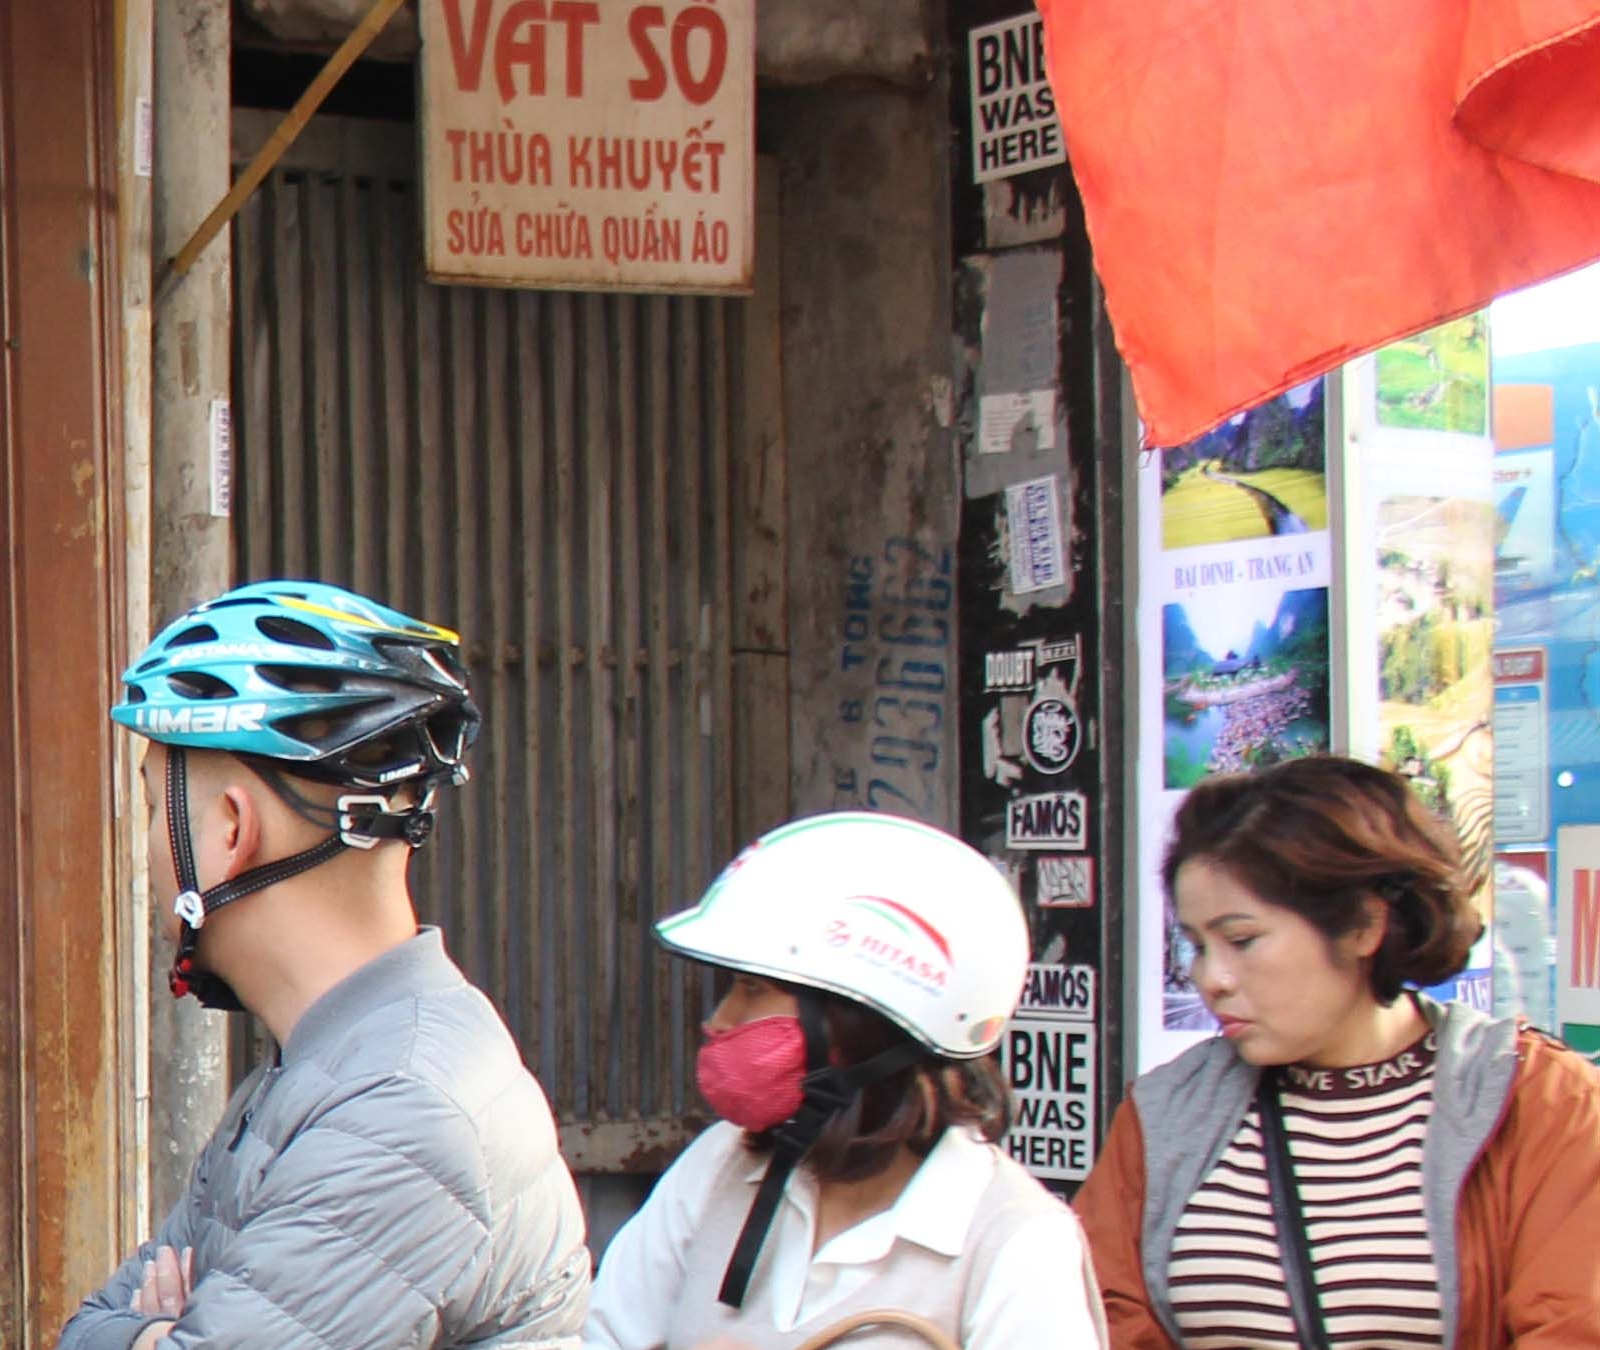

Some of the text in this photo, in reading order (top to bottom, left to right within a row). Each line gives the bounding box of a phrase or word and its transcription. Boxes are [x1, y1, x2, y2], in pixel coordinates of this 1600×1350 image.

[979, 87, 1056, 133] WAS
[446, 118, 725, 193] THÙA KHUYẾT
[979, 123, 1058, 172] HERE
[1009, 1030, 1088, 1094] BNE
[1344, 1052, 1422, 1089] STAR
[1007, 1134, 1086, 1169] HERE
